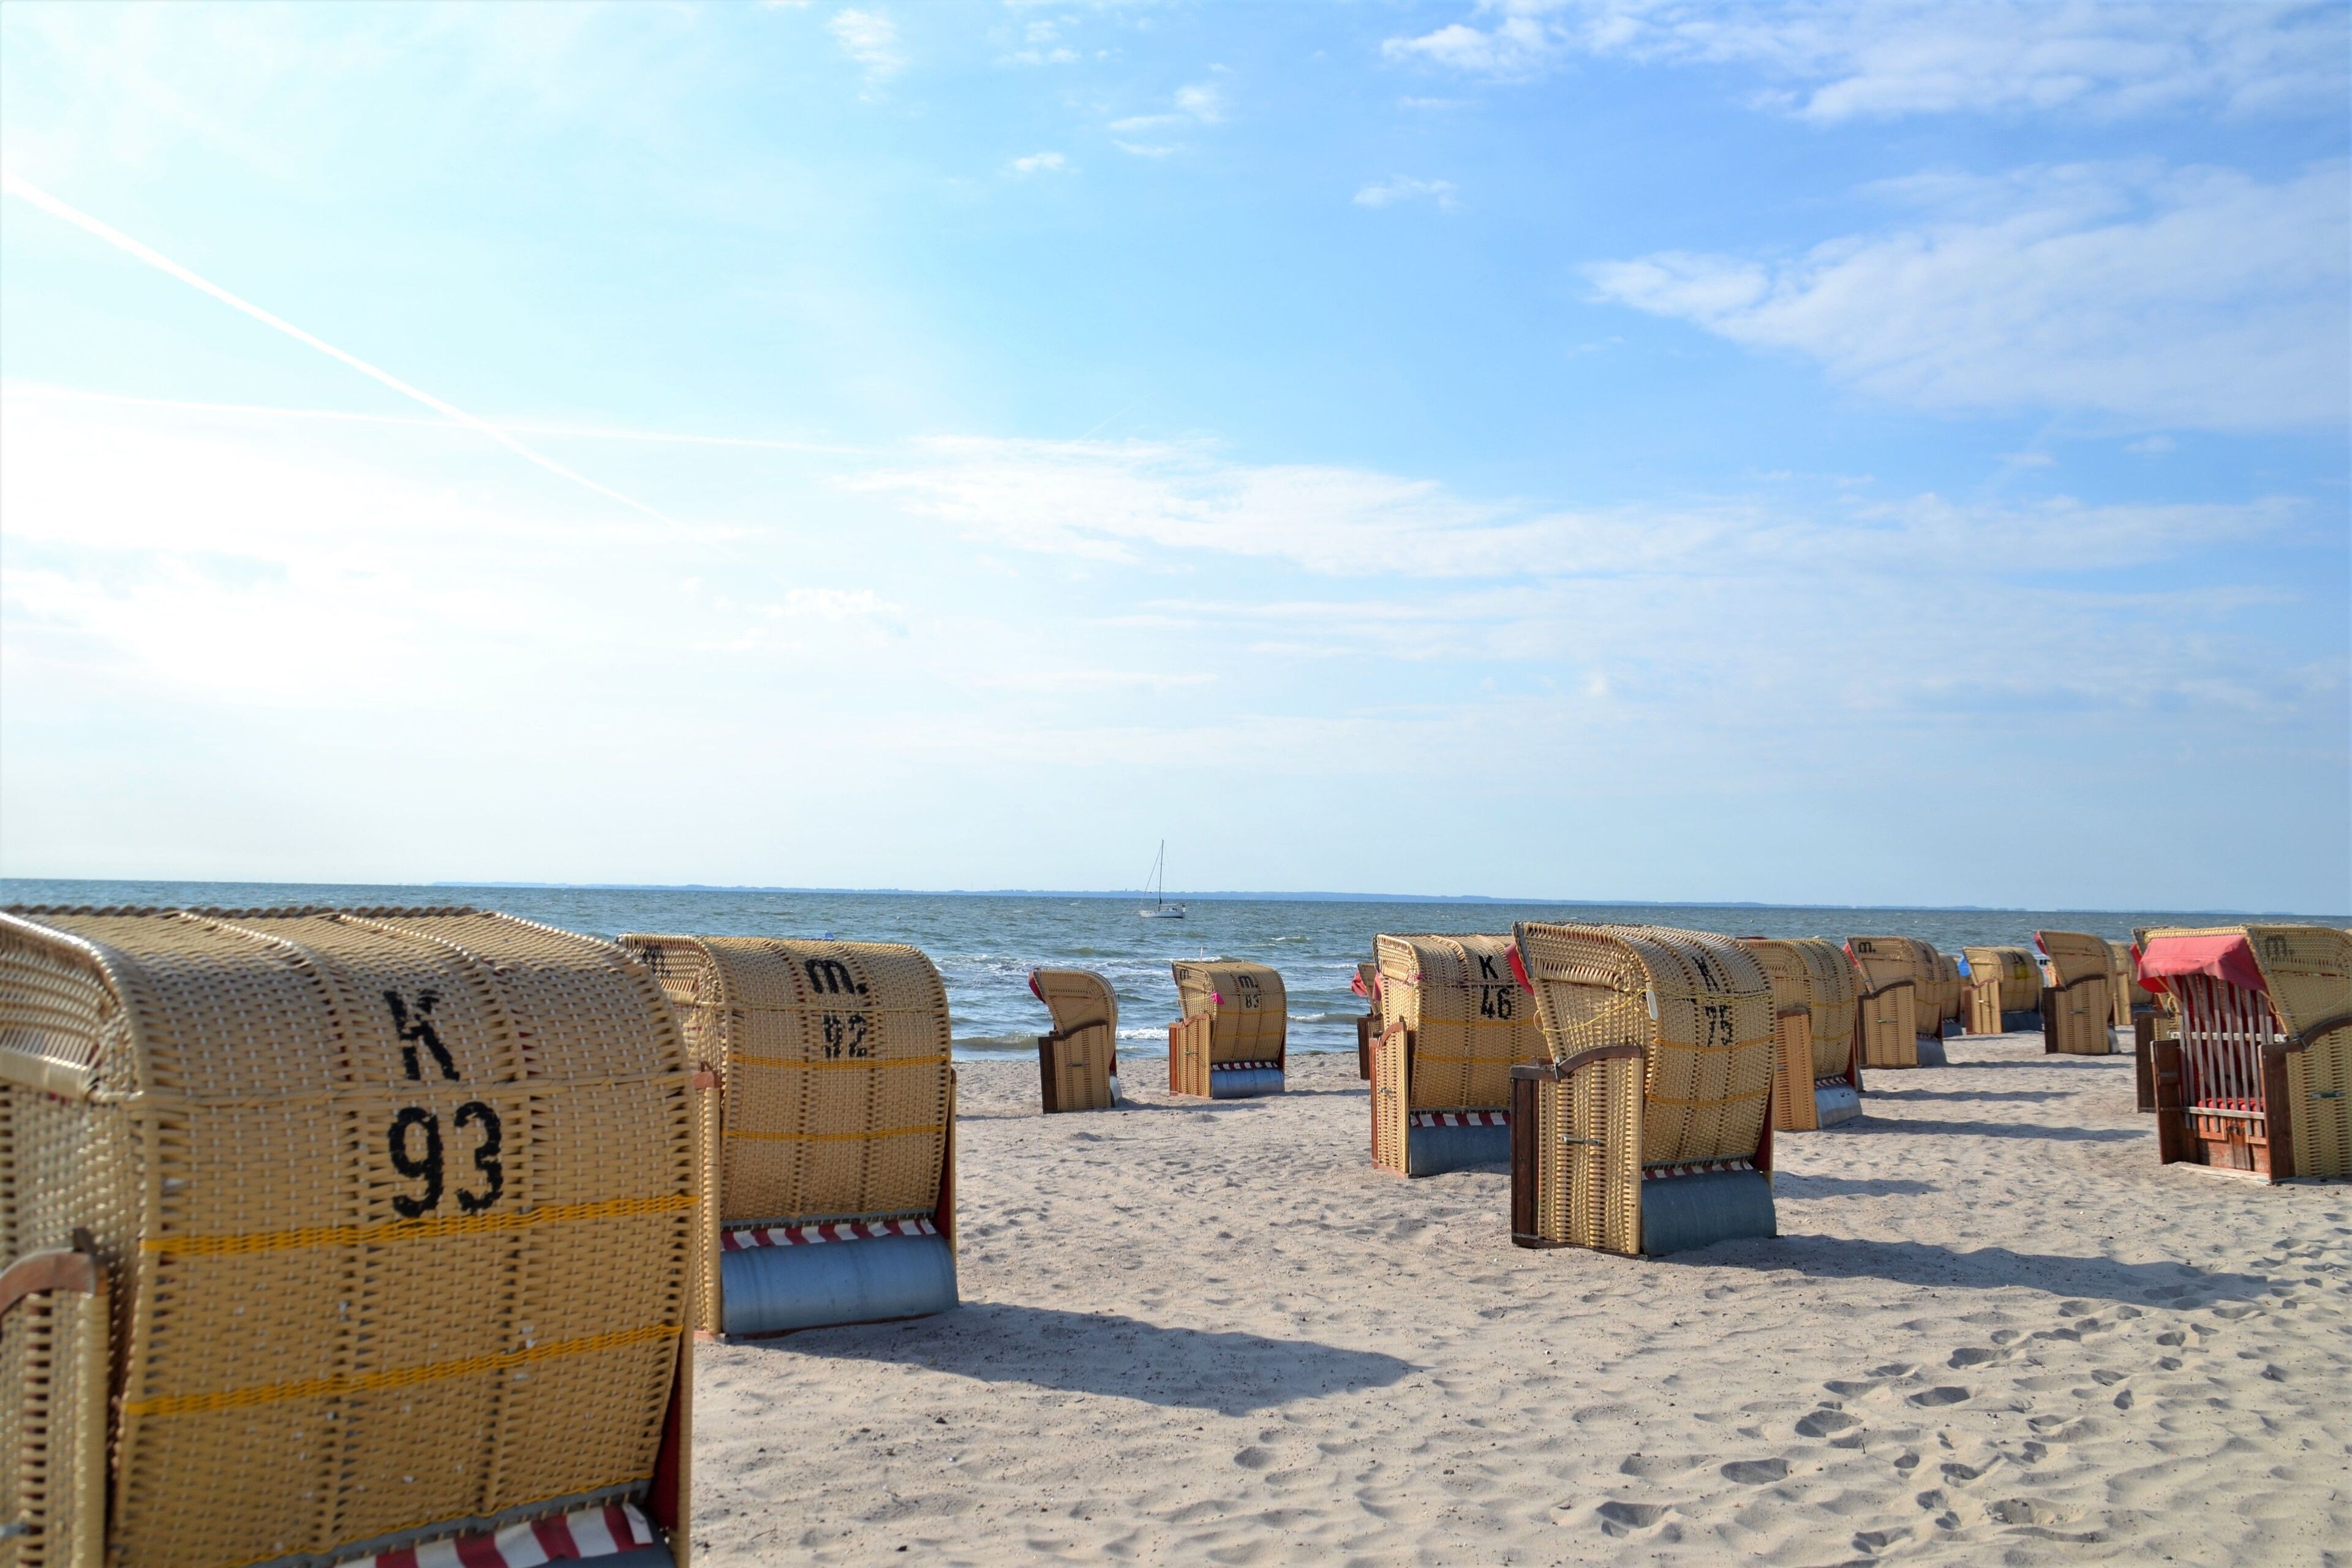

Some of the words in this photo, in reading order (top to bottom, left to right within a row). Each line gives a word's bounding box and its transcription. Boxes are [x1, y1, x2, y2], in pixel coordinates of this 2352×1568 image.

[1478, 955, 1499, 979] K
[1692, 956, 1720, 992] K
[1480, 984, 1512, 1020] 46
[383, 989, 461, 1082] K
[1704, 1005, 1733, 1047] 75
[388, 1101, 503, 1218] 93
